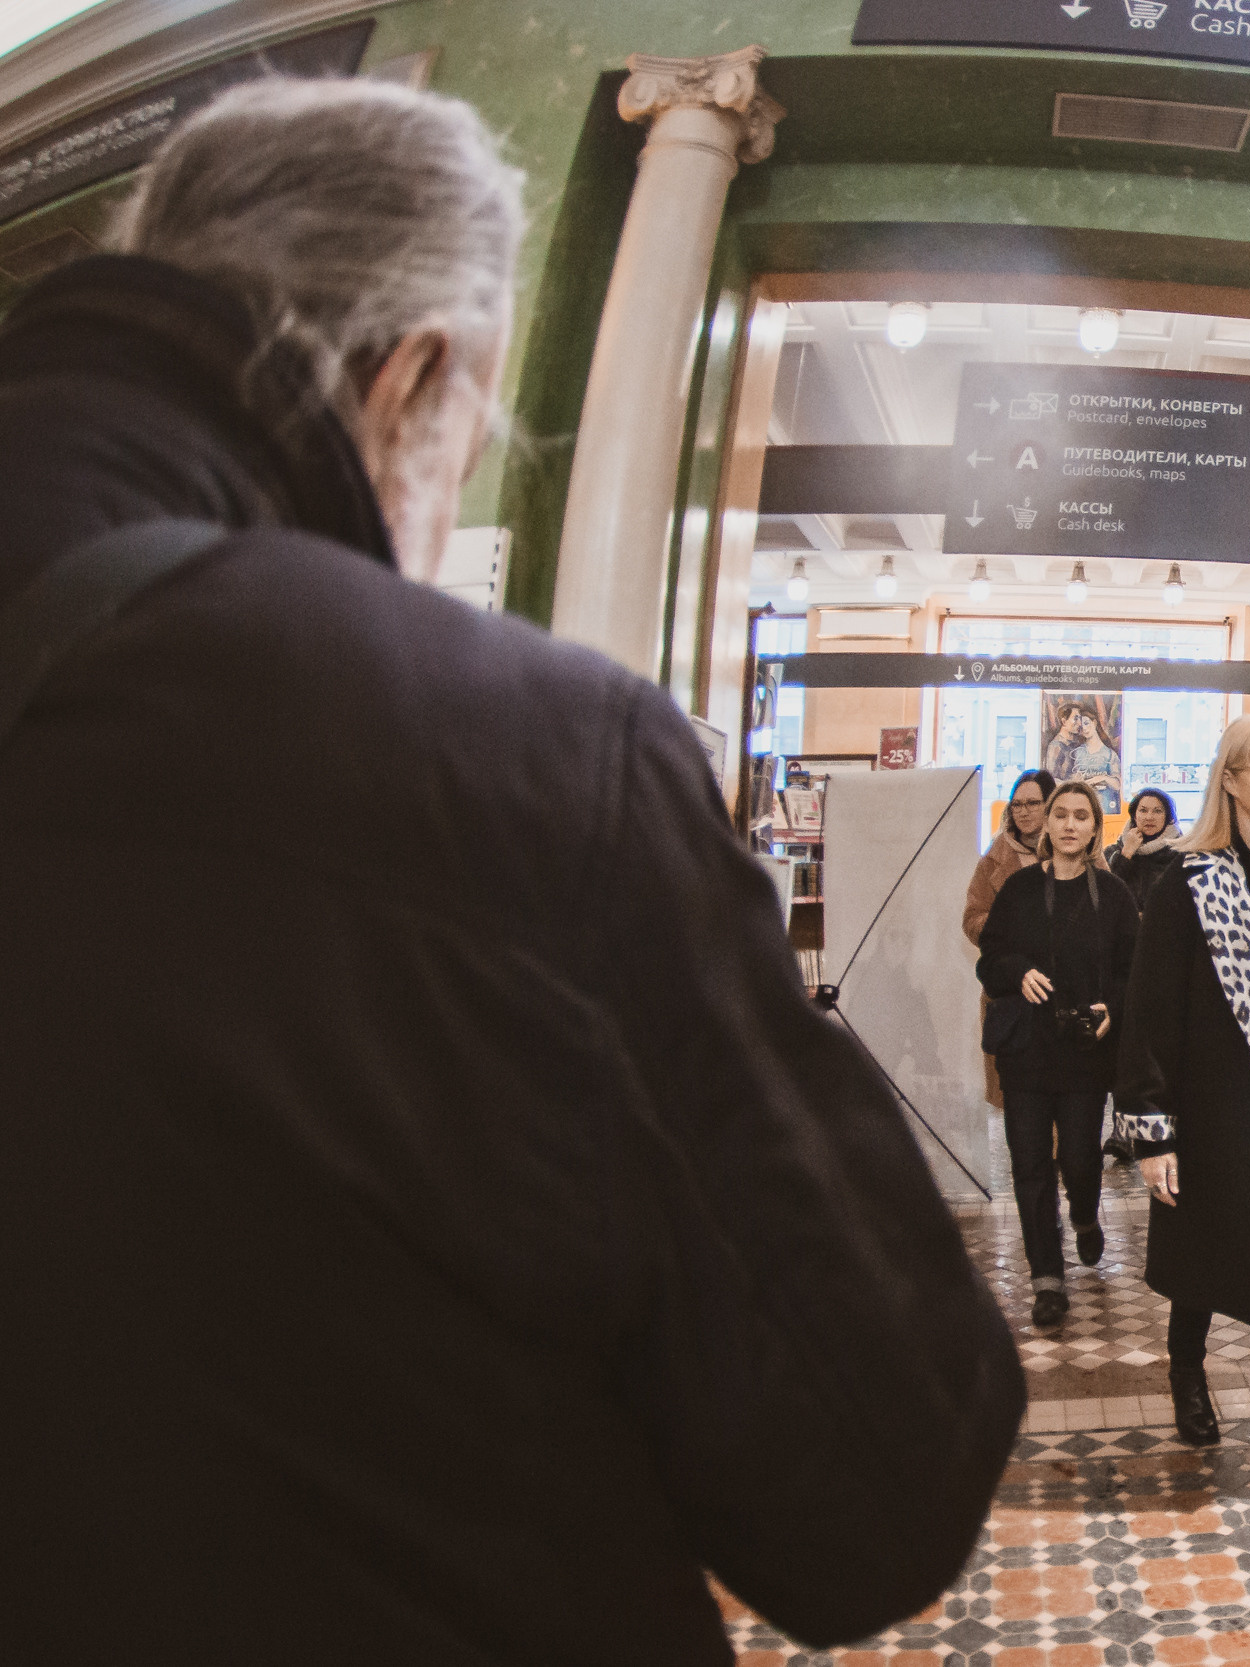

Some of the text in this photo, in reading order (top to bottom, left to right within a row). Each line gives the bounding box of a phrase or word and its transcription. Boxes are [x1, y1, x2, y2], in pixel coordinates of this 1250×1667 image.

[1191, 13, 1250, 37] Cash
[1069, 394, 1243, 415] ОТКРЫТКИ, КОНВЕРТЫ
[1067, 410, 1207, 429] Postcard, envelopes
[1063, 446, 1247, 468] ПУТЕВОДИТЕЛИ, КАРТЫ
[1062, 463, 1186, 482] Guidebooks, maps
[1059, 501, 1113, 516] КАССЫ
[1057, 517, 1125, 532] Cash desk
[991, 664, 1151, 675] АЛЬБОМЫ, ПУТЕВОДИТЕЛИ, КАРТЫ
[990, 674, 1100, 684] Albums, guidebooks, maps
[882, 749, 914, 763] -25%
